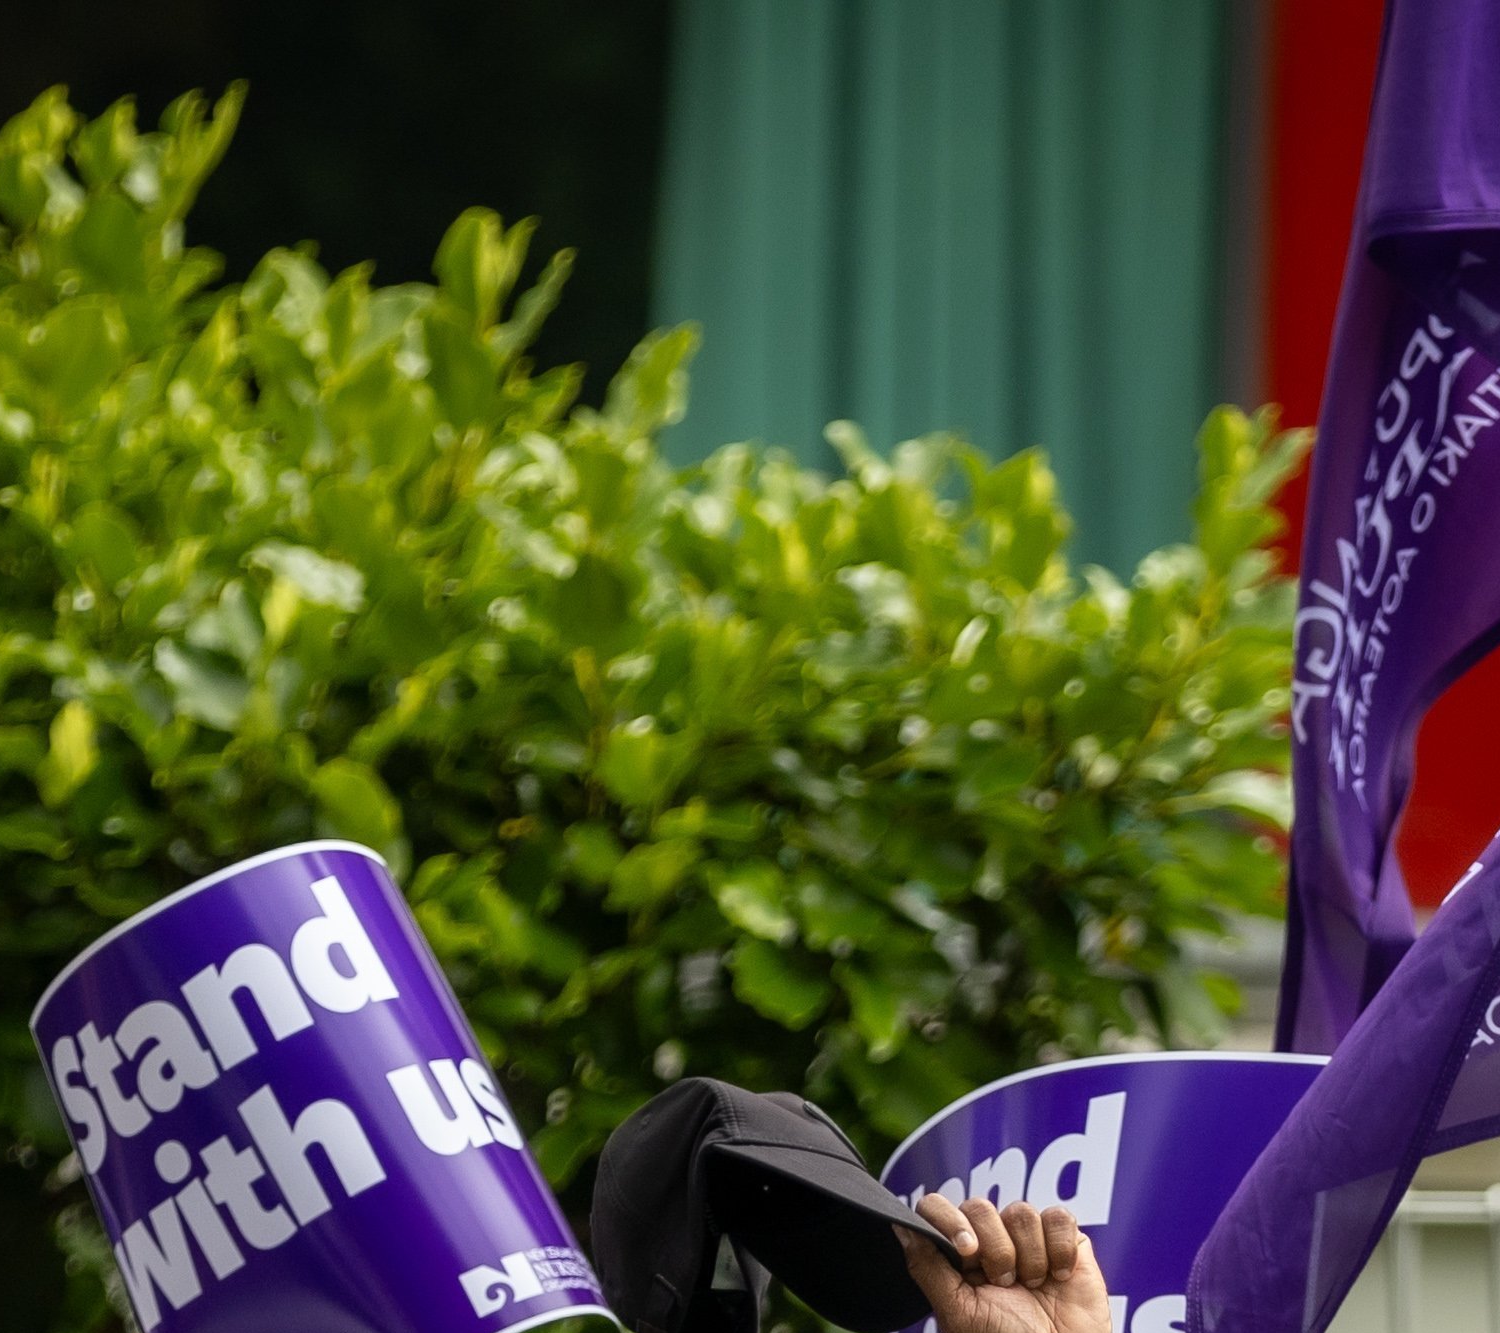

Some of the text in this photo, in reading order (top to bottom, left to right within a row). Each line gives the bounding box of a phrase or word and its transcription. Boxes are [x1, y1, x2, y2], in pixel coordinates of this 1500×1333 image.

[53, 875, 400, 1175] Stand
[115, 1057, 524, 1331] with us
